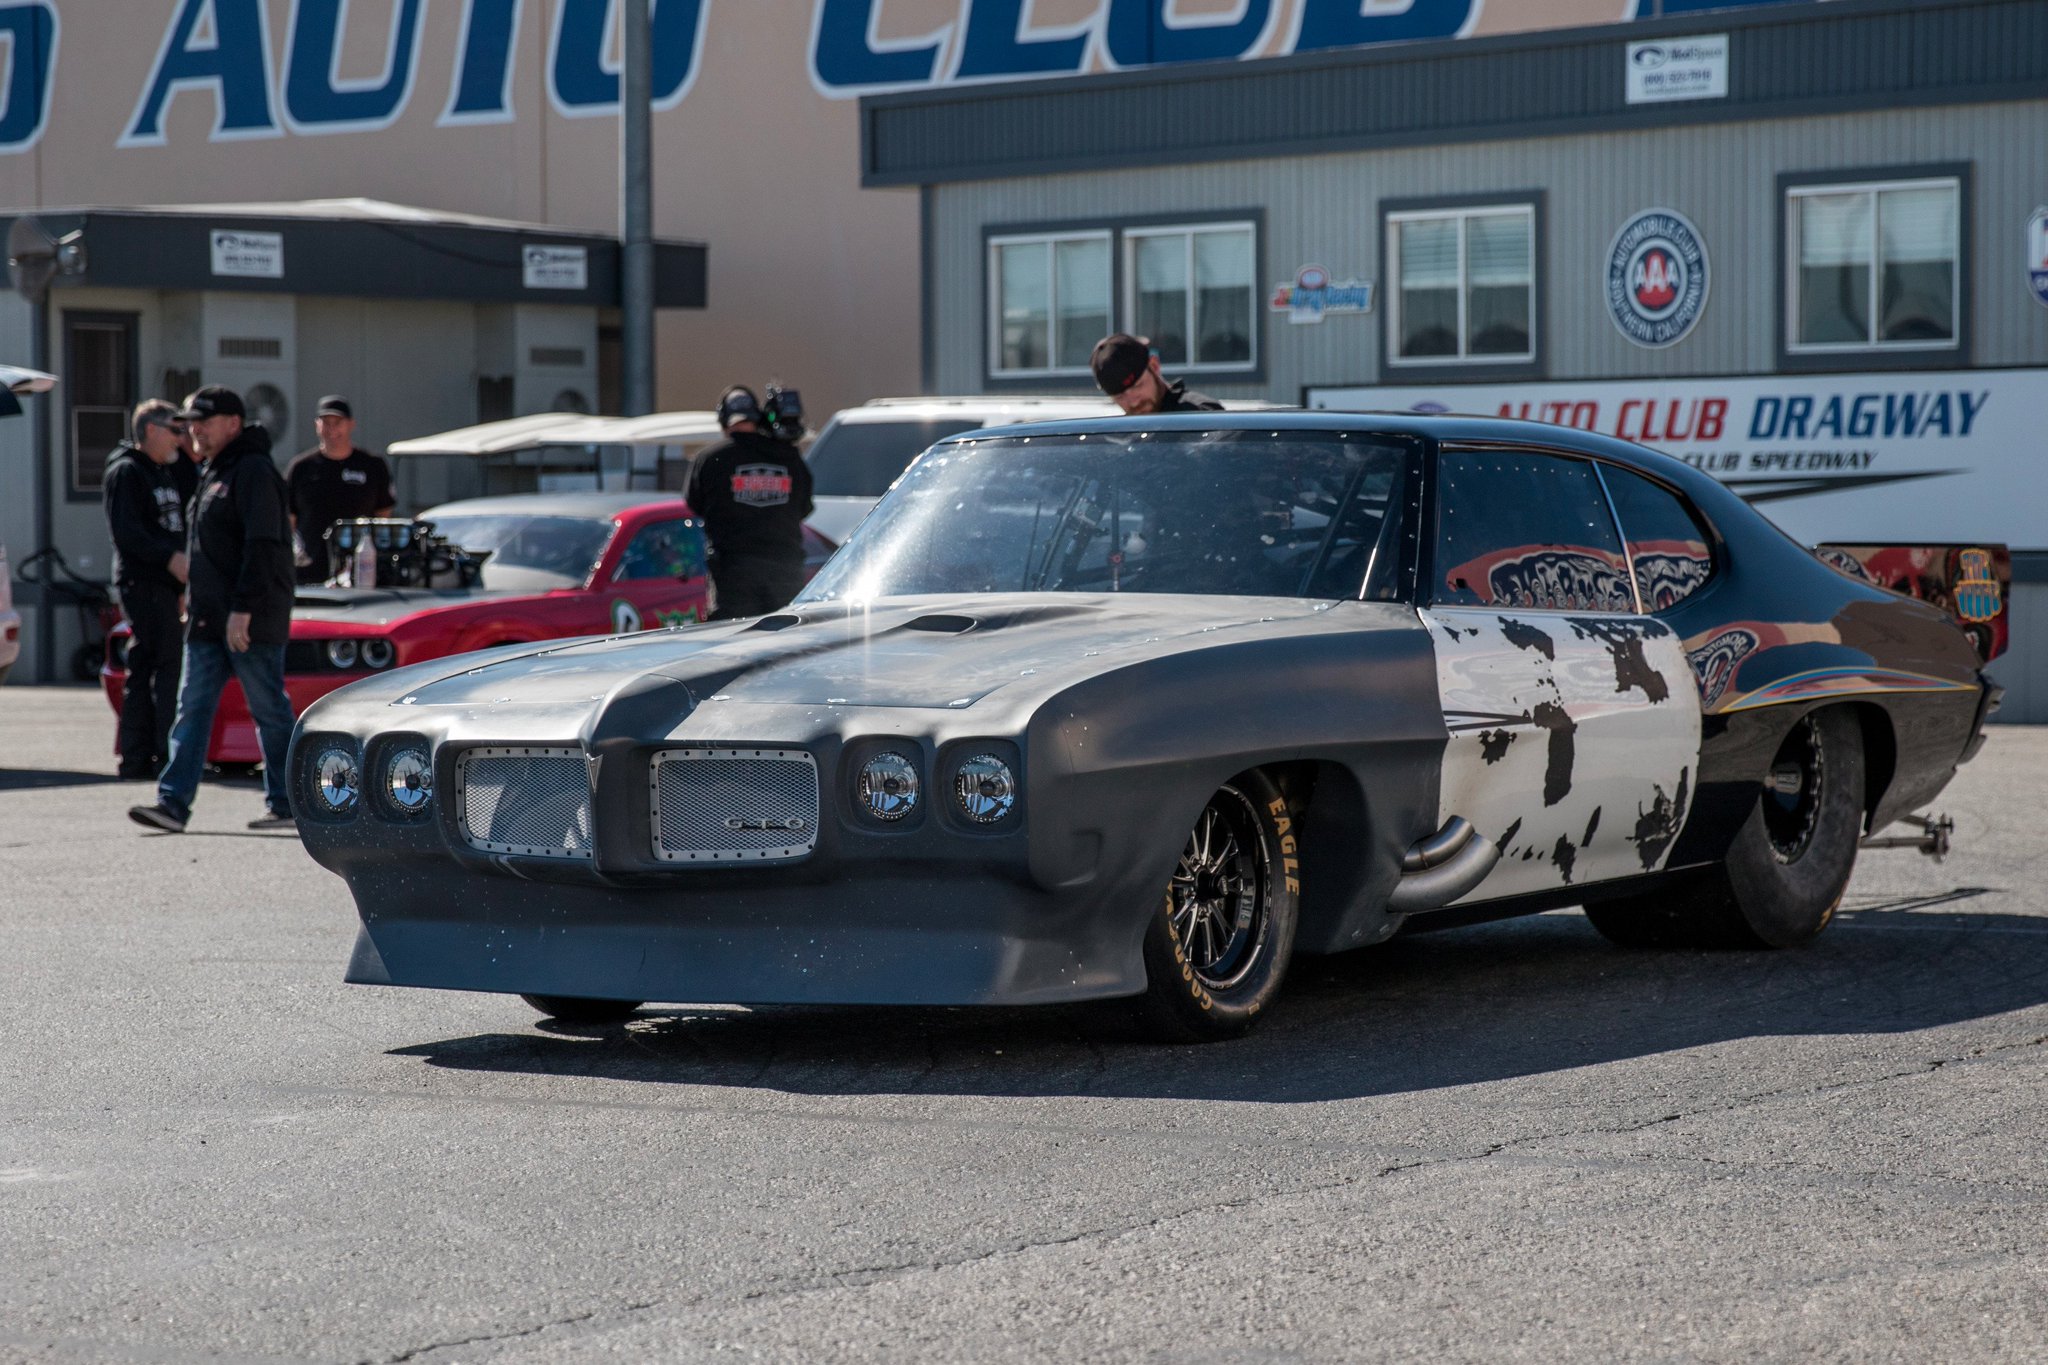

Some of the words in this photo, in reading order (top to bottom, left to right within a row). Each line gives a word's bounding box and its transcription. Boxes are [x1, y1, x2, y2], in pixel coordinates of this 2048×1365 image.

[1634, 254, 1680, 288] AAA
[1612, 398, 1731, 442] CLUB
[1748, 390, 1989, 440] DRAGWAY
[1750, 449, 1878, 471] SPEEDWAY
[724, 816, 806, 832] GTO
[1268, 797, 1300, 897] EAGLE
